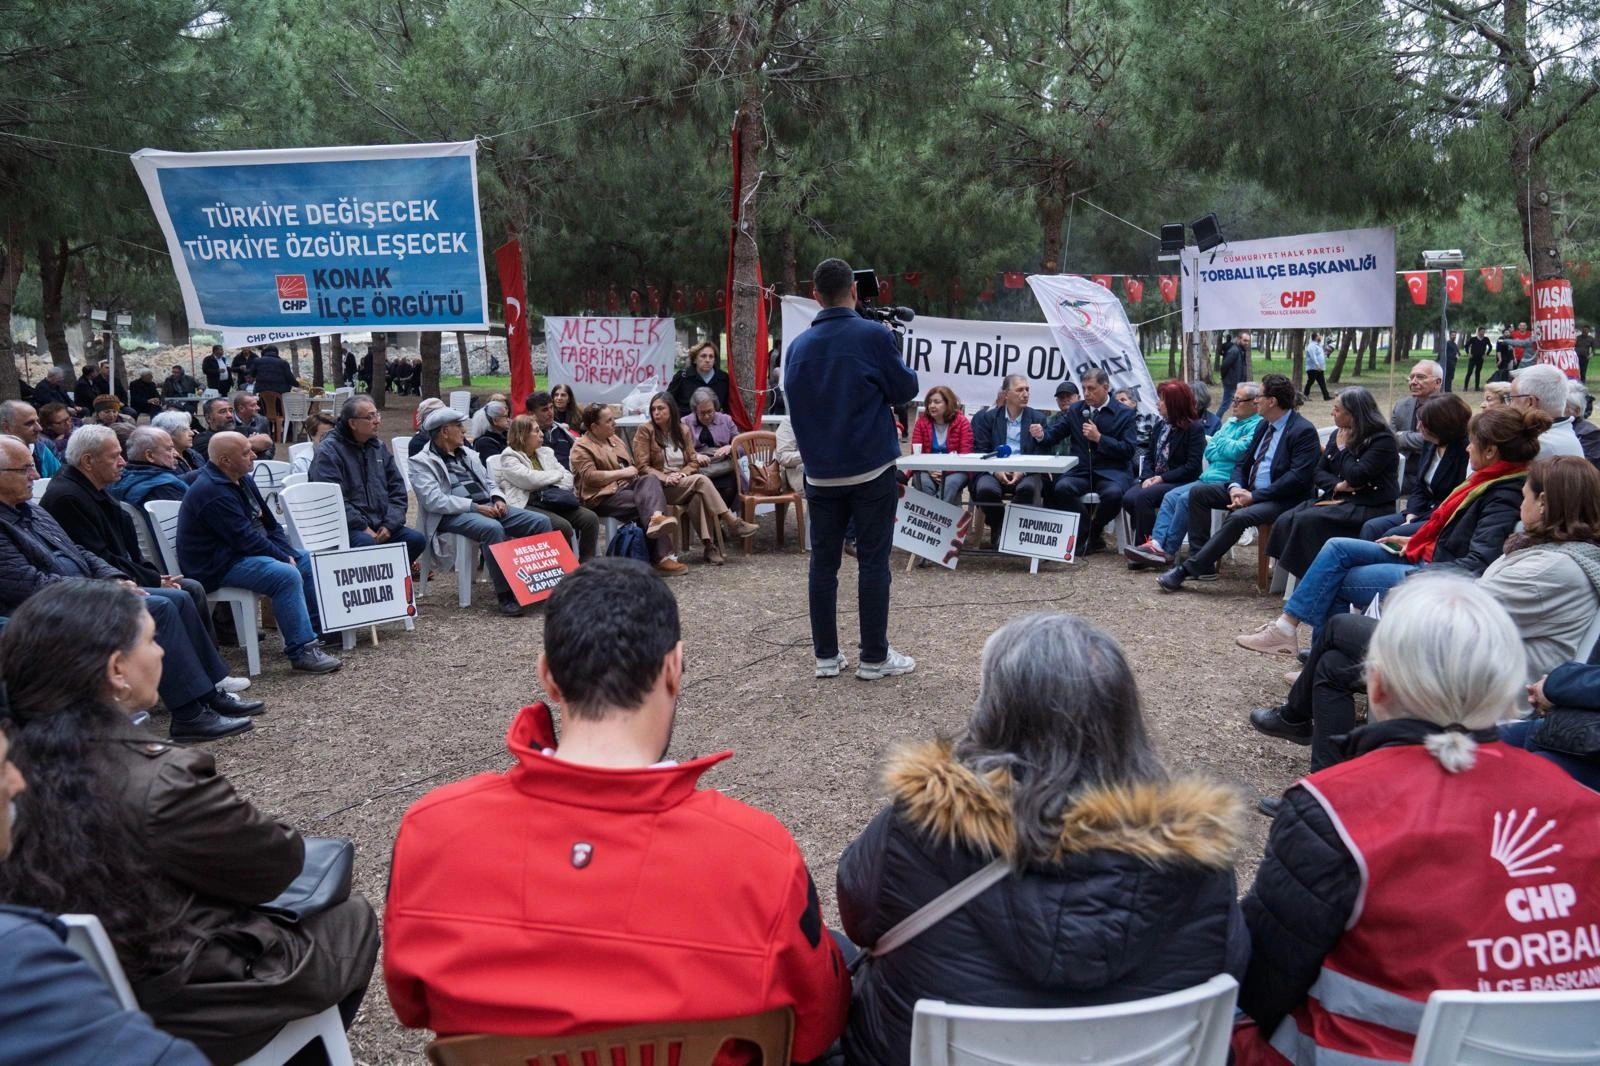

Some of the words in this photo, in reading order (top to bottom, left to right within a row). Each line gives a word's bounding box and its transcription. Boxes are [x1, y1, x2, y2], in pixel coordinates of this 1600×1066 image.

[202, 201, 300, 228] TÜRKİYE
[305, 197, 440, 229] DEĞİŞECEK
[184, 233, 280, 260] TÜRKİYE
[286, 231, 469, 260] ÖZGÜRLEŞECEK
[1223, 252, 1278, 263] CUMHURİYET
[1281, 249, 1304, 258] HALK
[1307, 245, 1345, 256] PARTİSİ
[312, 267, 393, 290] KONAK
[1200, 267, 1254, 283] TORBALI
[1256, 264, 1285, 281] İLÇE
[1288, 254, 1377, 278] BAŞKANLIĞI
[282, 300, 307, 311] CHP
[316, 292, 371, 323] İLÇE
[372, 290, 464, 317] ÖRGÜTÜ
[1280, 290, 1316, 308] CHP
[246, 333, 267, 343] CHP
[560, 319, 664, 345] MESLEK
[560, 345, 640, 368] FABRİKASI
[941, 335, 1021, 377] TABİP
[1027, 346, 1071, 381] OD
[904, 501, 953, 528] SATILMAMIŞ
[907, 515, 942, 535] FABRİKA
[1019, 517, 1063, 534] TAPUMUZU
[900, 525, 926, 542] KALDI
[926, 536, 941, 547] MI?
[1019, 531, 1058, 547] ÇALDILAR
[513, 548, 560, 566] FABRİKASI
[514, 541, 551, 556] MESLEK
[333, 562, 394, 587] TAPUMUZU
[524, 557, 559, 572] HALKIN
[532, 567, 565, 582] EKMEK
[341, 584, 394, 614] ÇALDILAR
[1504, 882, 1577, 923] CHP
[1467, 923, 1600, 973] TORBAL
